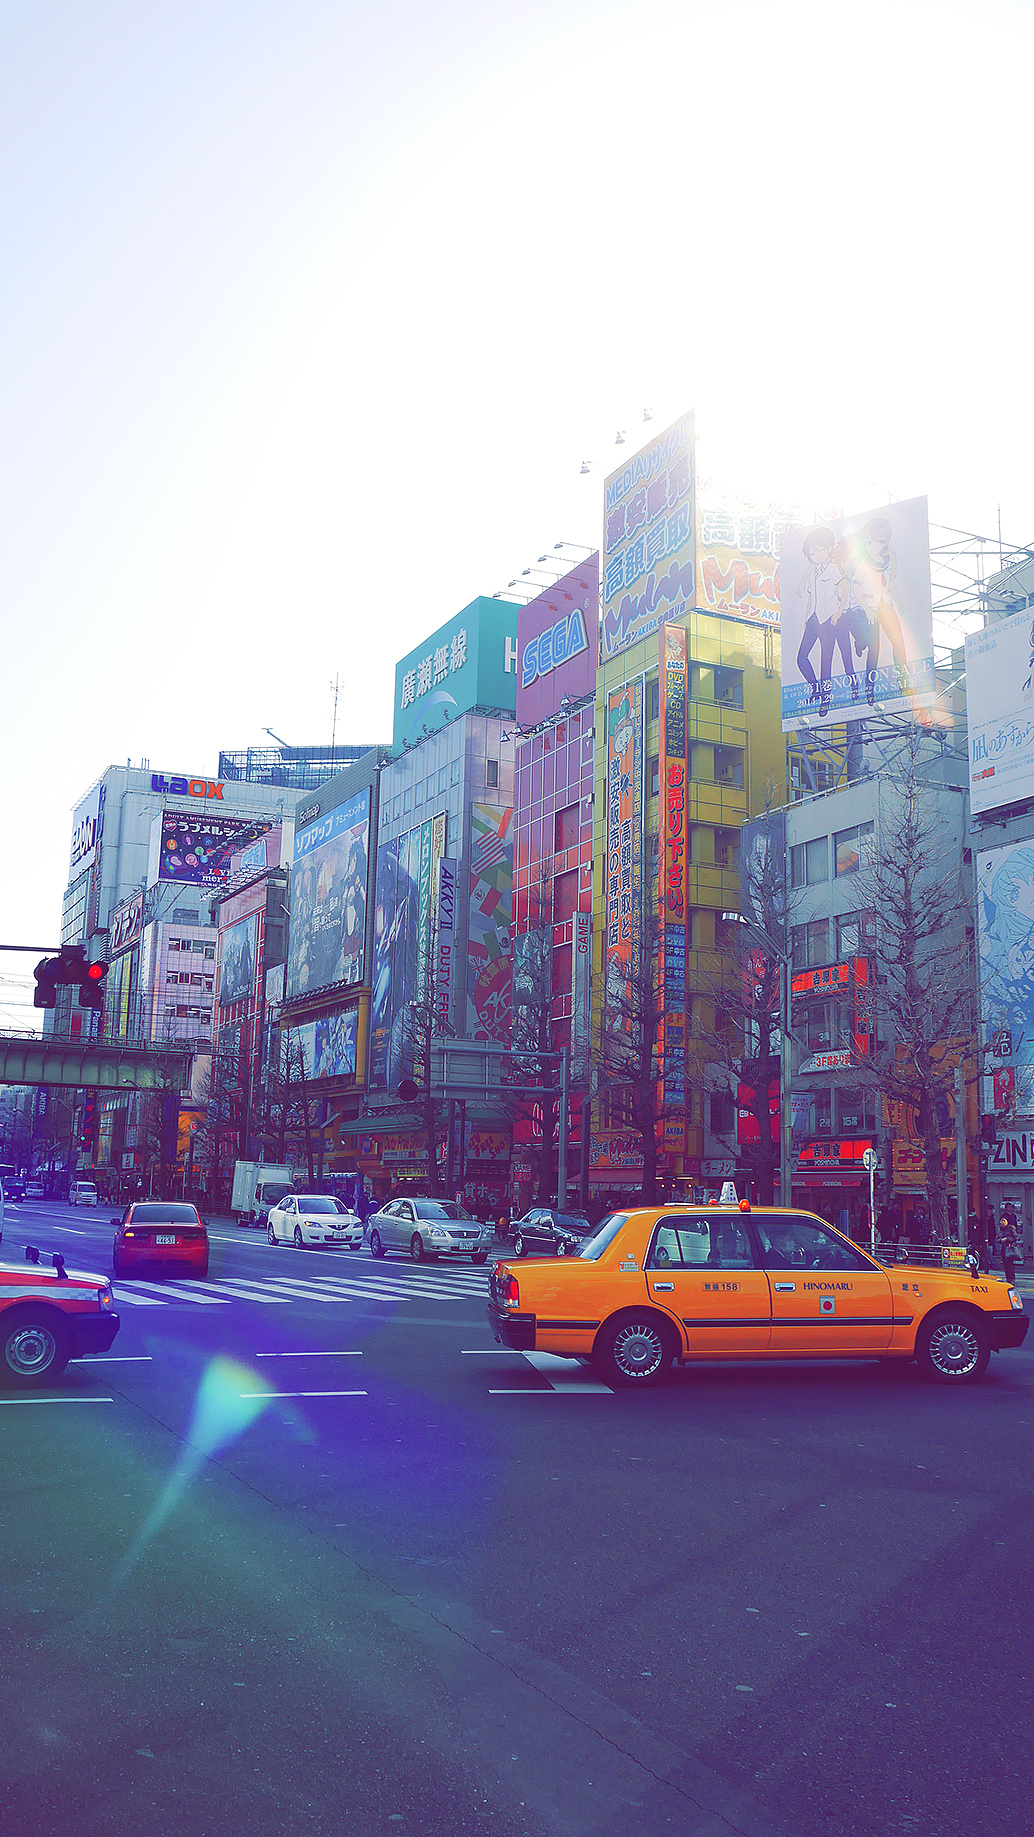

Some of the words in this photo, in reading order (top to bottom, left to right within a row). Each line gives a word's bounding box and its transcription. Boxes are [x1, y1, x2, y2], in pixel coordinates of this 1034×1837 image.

[605, 501, 691, 603] 高額買取
[604, 560, 694, 655] Mulan
[717, 599, 760, 617] ムーラン
[638, 619, 657, 640] AKIBA
[521, 608, 590, 690] SEGA
[668, 671, 684, 681] DVD
[832, 673, 865, 691] NOW
[868, 667, 889, 683] ON
[892, 659, 933, 679] SALE
[874, 682, 889, 694] ON
[669, 700, 682, 710] CD
[667, 719, 685, 729] アニメ
[667, 728, 684, 738] コミック
[296, 815, 334, 854] ソフマップ
[440, 865, 454, 920] AKKY
[577, 917, 589, 954] GAME
[440, 945, 451, 988] DUTY
[667, 960, 685, 969] DVD
[667, 1012, 684, 1022] 2F
[665, 1127, 685, 1136] AKIBA
[705, 1162, 732, 1175] ラーメン
[704, 1283, 720, 1291] 無線
[721, 1282, 738, 1291] 158
[802, 1281, 854, 1291] HINOMARU
[970, 1285, 989, 1294] TAXI
